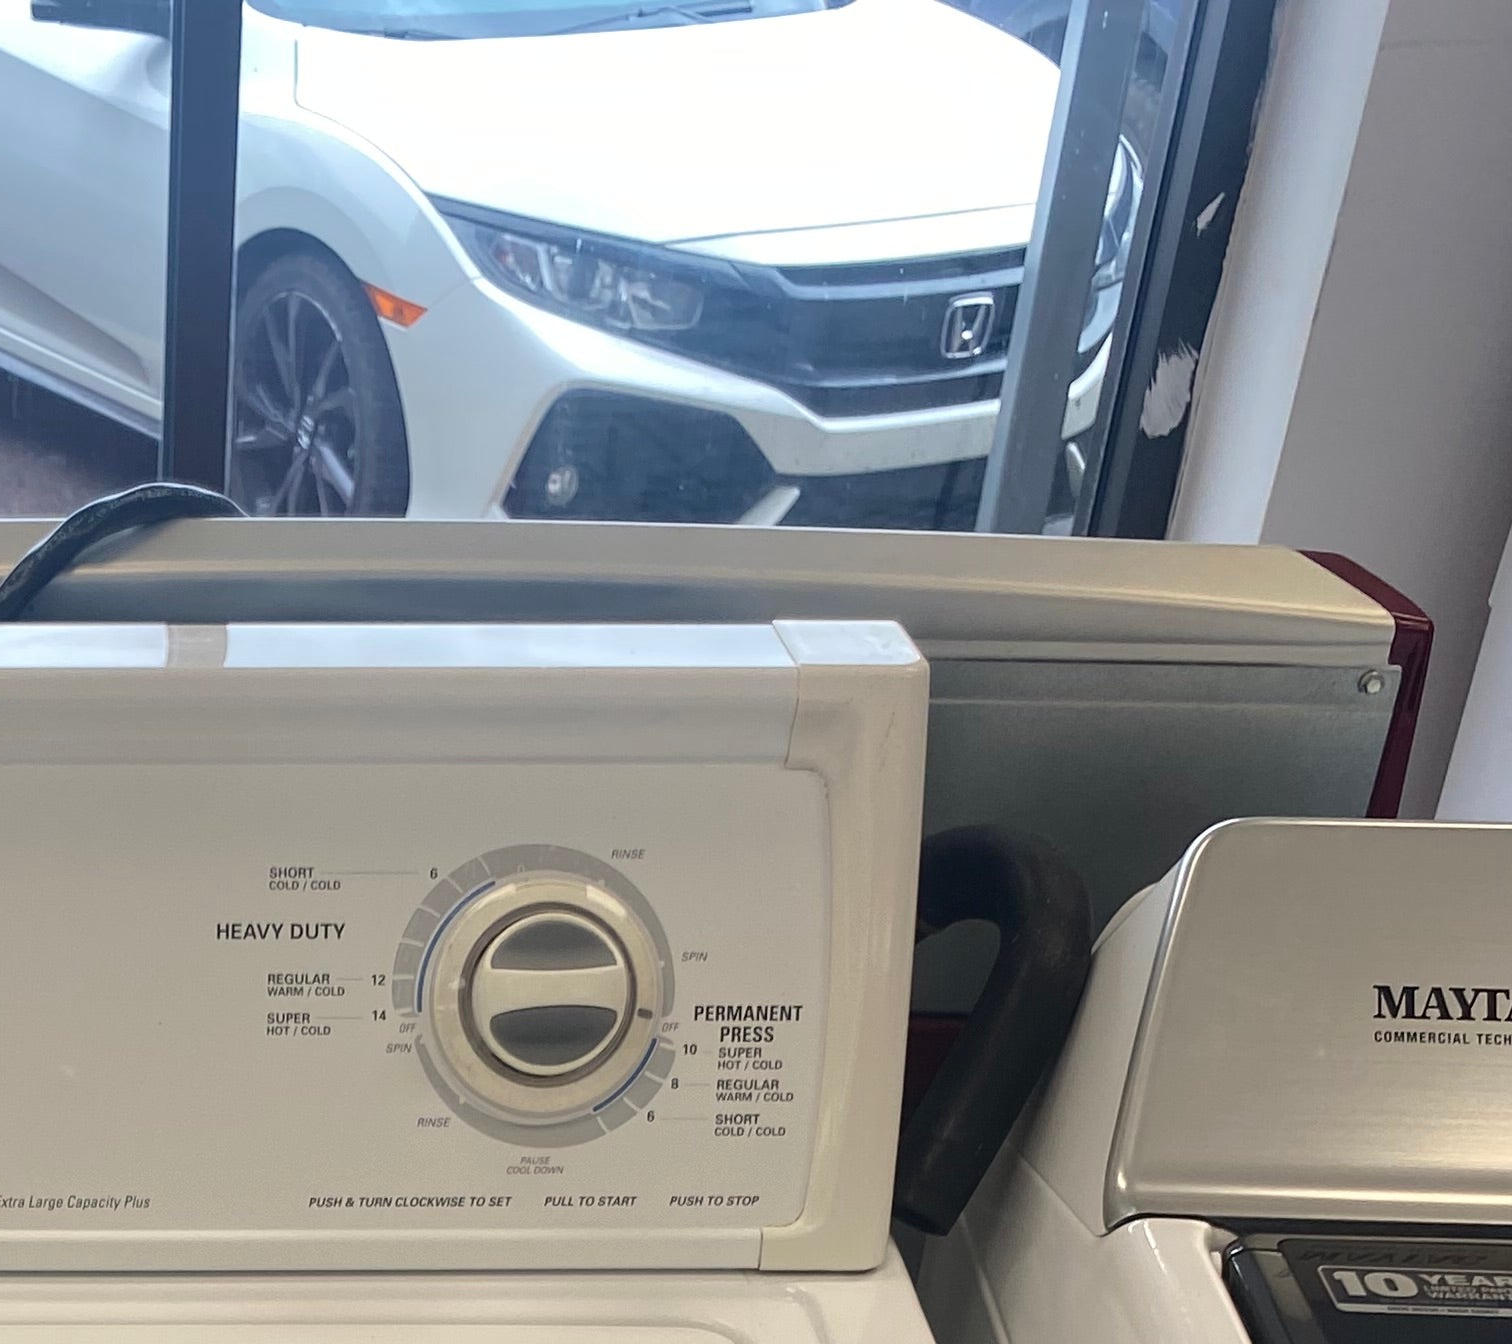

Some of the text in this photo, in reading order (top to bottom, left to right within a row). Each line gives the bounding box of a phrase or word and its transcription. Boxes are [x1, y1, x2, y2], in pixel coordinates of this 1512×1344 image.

[610, 849, 646, 860] RINSE
[269, 867, 314, 879] SHORT
[430, 868, 438, 879] 6
[269, 881, 299, 891] COLD
[310, 881, 341, 891] COLD
[216, 923, 346, 940] HEAVY DUTY
[681, 952, 708, 962] SPIN
[267, 973, 330, 985] REGULAR
[371, 975, 386, 986] 12
[267, 986, 304, 996] WARM
[314, 987, 345, 997] COLD
[372, 1010, 386, 1021] 14
[694, 1005, 803, 1021] PERMANENT
[267, 1013, 310, 1025] SUPER
[267, 1027, 290, 1037] HOT
[301, 1027, 331, 1037] COLD
[399, 1023, 416, 1033] OFF
[661, 1023, 679, 1033] OFF
[719, 1026, 775, 1042] PRESS
[1374, 1030, 1470, 1045] COMMERCIAL
[385, 1043, 412, 1054] SPIN
[683, 1044, 698, 1055] 10
[718, 1047, 763, 1059] SUPER
[717, 1060, 741, 1070] HOT
[752, 1060, 783, 1070] COLD
[671, 1079, 679, 1089] 8
[716, 1080, 780, 1091] REGULAR
[716, 1092, 753, 1102] WARM
[763, 1092, 794, 1102] COLD
[416, 1117, 451, 1128] RINSE
[647, 1112, 655, 1122] 6
[714, 1114, 760, 1125] SHORT
[714, 1127, 745, 1137] COLD
[755, 1127, 786, 1137] COLD
[520, 1156, 551, 1166] PAUSE
[506, 1166, 564, 1175] COOL DOWN
[29, 1195, 64, 1211] Large
[68, 1195, 121, 1211] Capacity
[124, 1195, 150, 1208] Plus
[308, 1197, 512, 1208] PUSH & TURN CLOCKWISE TO SET
[544, 1196, 637, 1207] PULL TO START
[669, 1196, 760, 1207] PUSH TO STOP
[1332, 1271, 1419, 1298] 10
